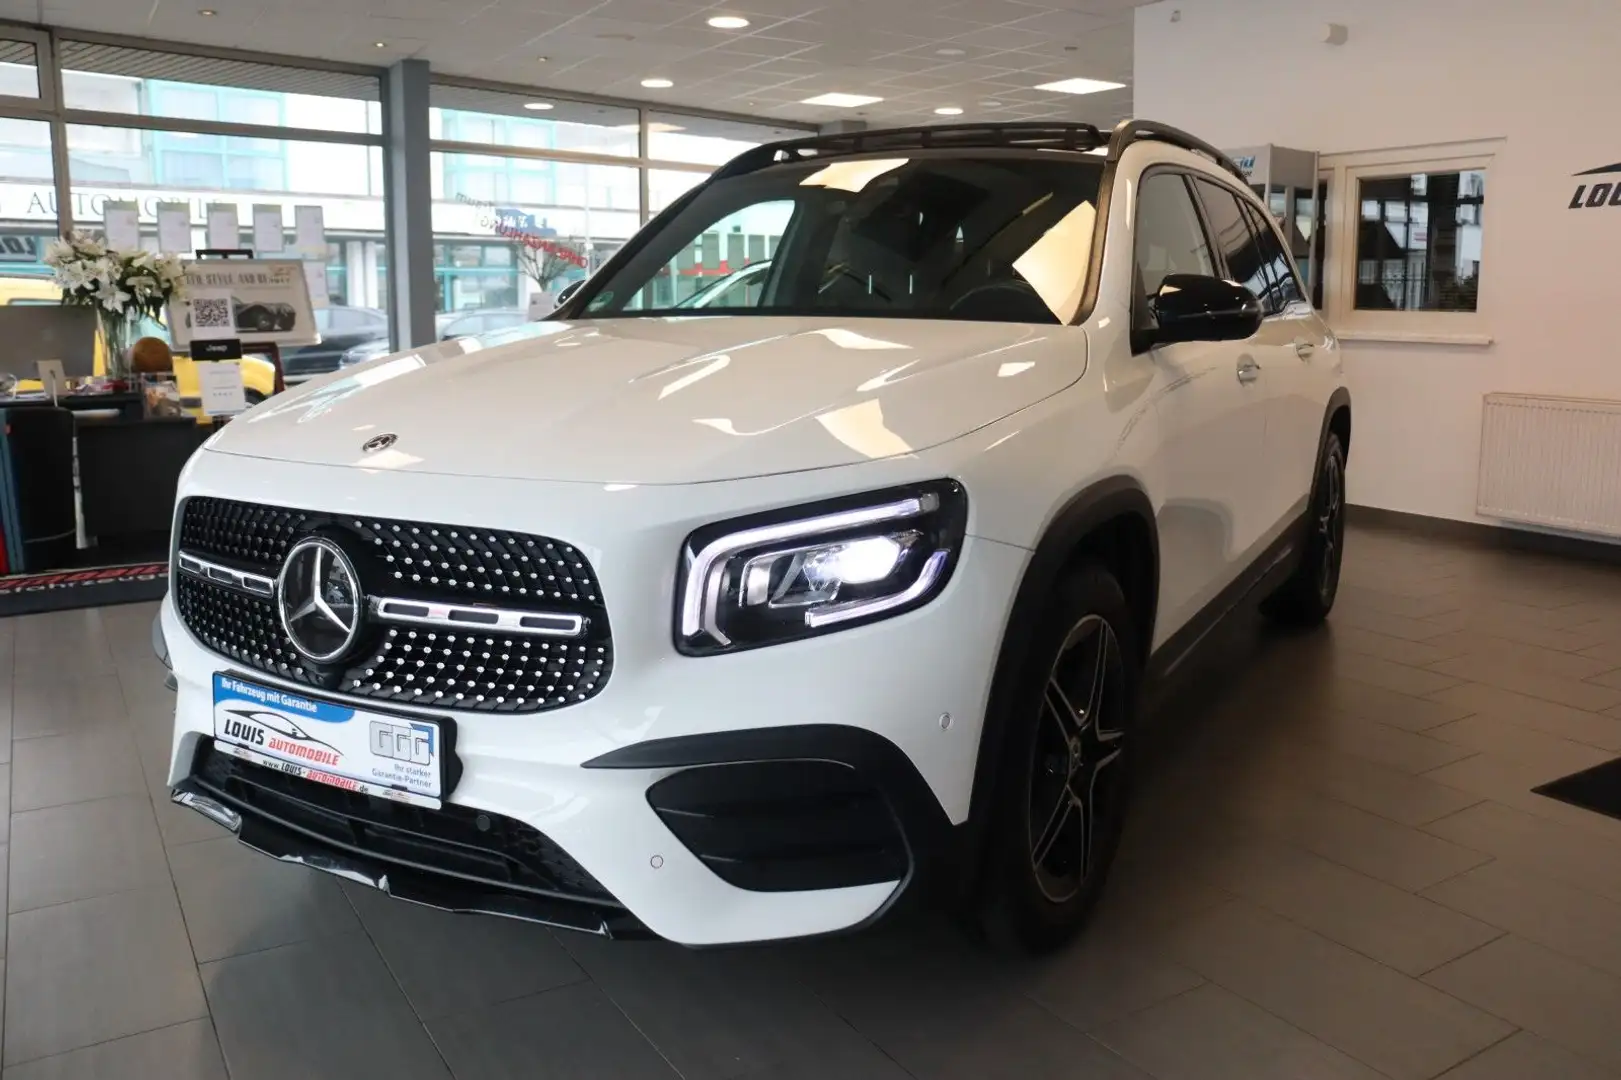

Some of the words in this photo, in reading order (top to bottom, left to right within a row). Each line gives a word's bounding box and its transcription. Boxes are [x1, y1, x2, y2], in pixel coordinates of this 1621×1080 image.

[221, 677, 232, 689] Ihr
[232, 680, 266, 702] Fahrzeug
[266, 692, 281, 704] mit
[281, 694, 318, 713] Garantie
[224, 718, 265, 746] LOUIS
